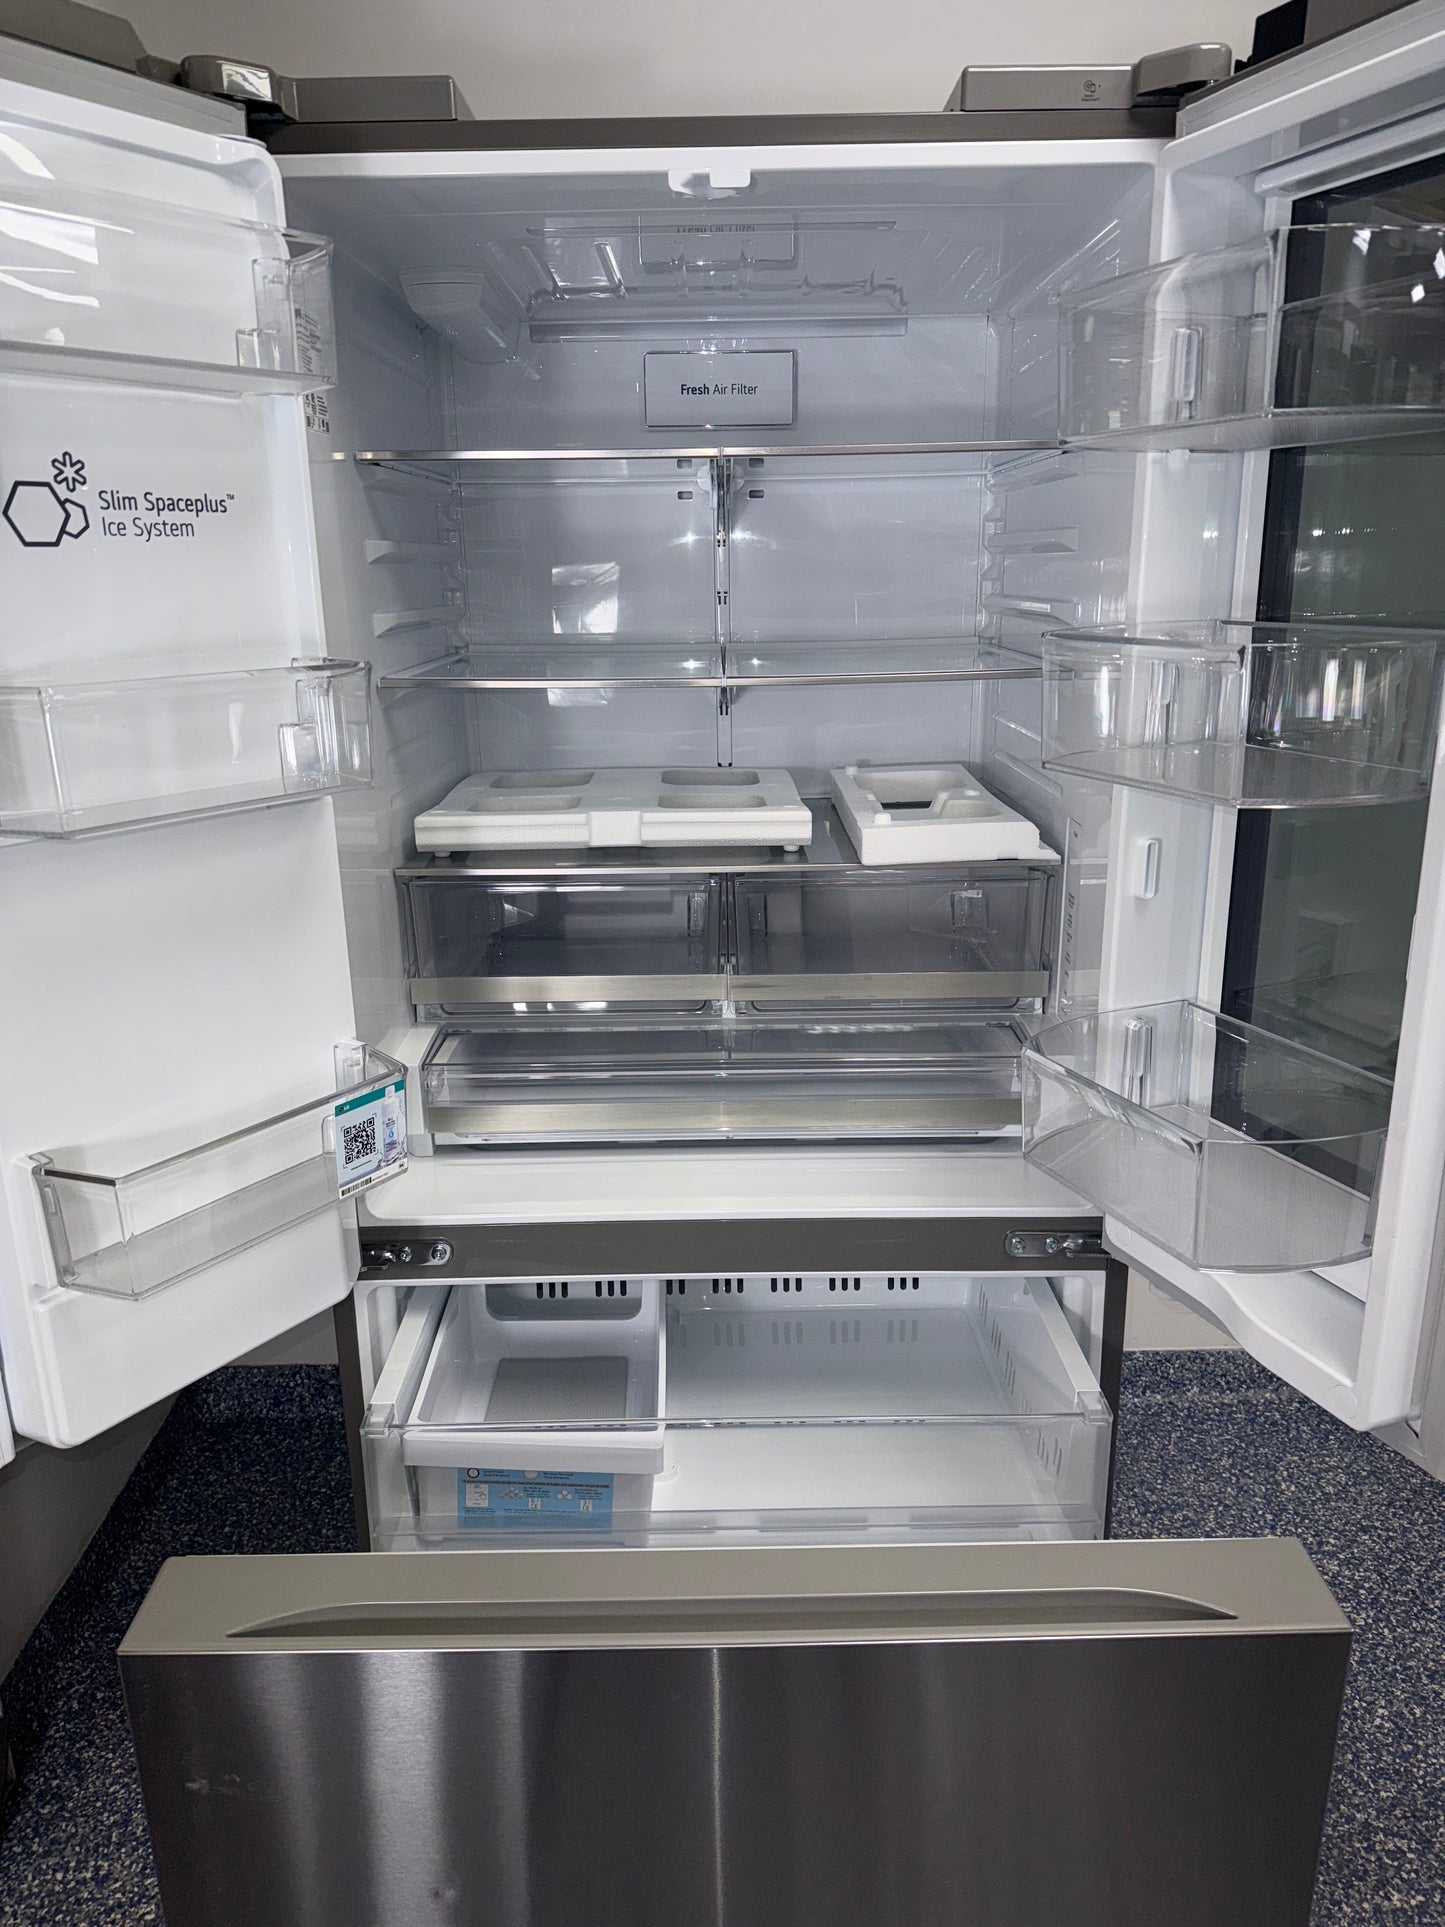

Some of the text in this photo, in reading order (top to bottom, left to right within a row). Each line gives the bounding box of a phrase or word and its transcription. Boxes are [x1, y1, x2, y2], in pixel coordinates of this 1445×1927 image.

[680, 383, 759, 396] Fresh Air Filter
[98, 490, 138, 512] Slim
[102, 516, 195, 543] Ice System
